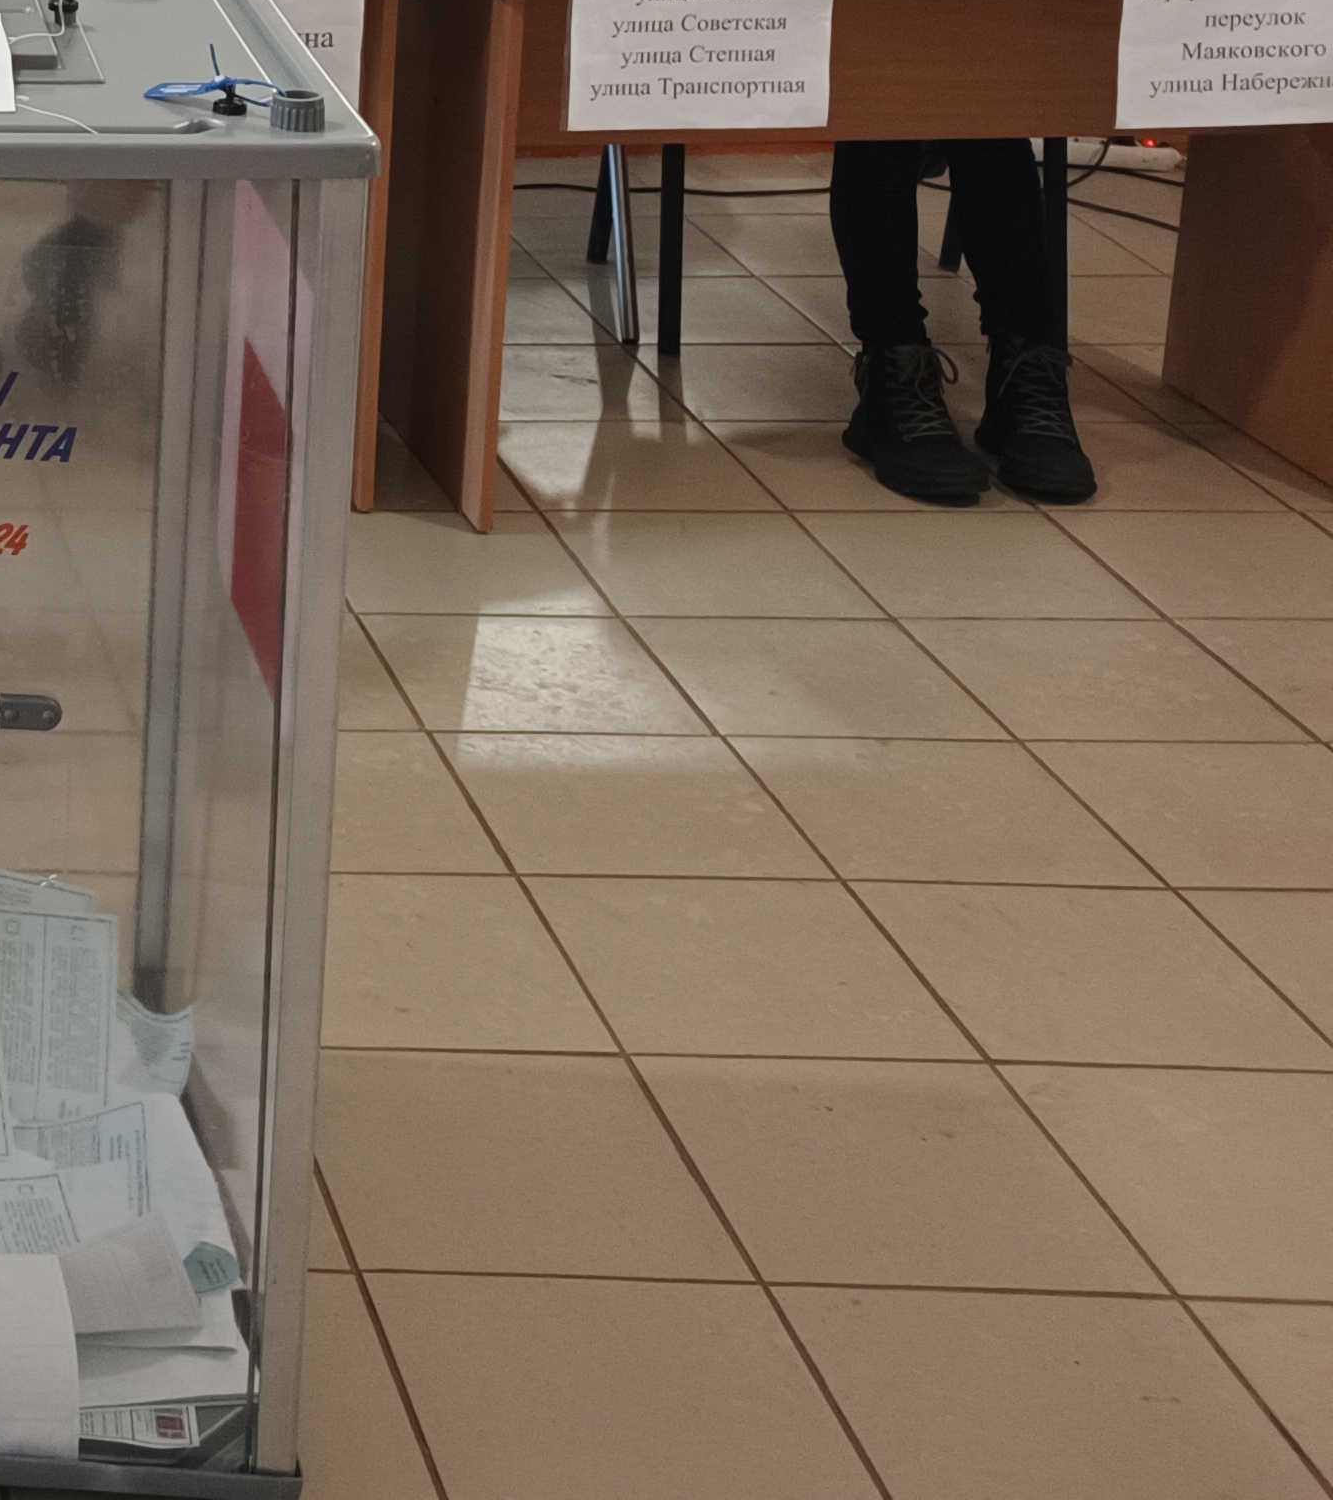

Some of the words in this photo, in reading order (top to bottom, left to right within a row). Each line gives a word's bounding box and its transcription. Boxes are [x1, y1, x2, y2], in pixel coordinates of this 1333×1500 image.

[612, 19, 674, 38] улица
[681, 14, 787, 33] Советская
[1205, 11, 1306, 31] переулок
[620, 50, 682, 69] улица
[689, 45, 775, 63] Степная
[1182, 42, 1327, 61] Маяковского
[590, 81, 650, 101] улица
[658, 77, 805, 100] Транспортная
[1150, 79, 1213, 98] улица
